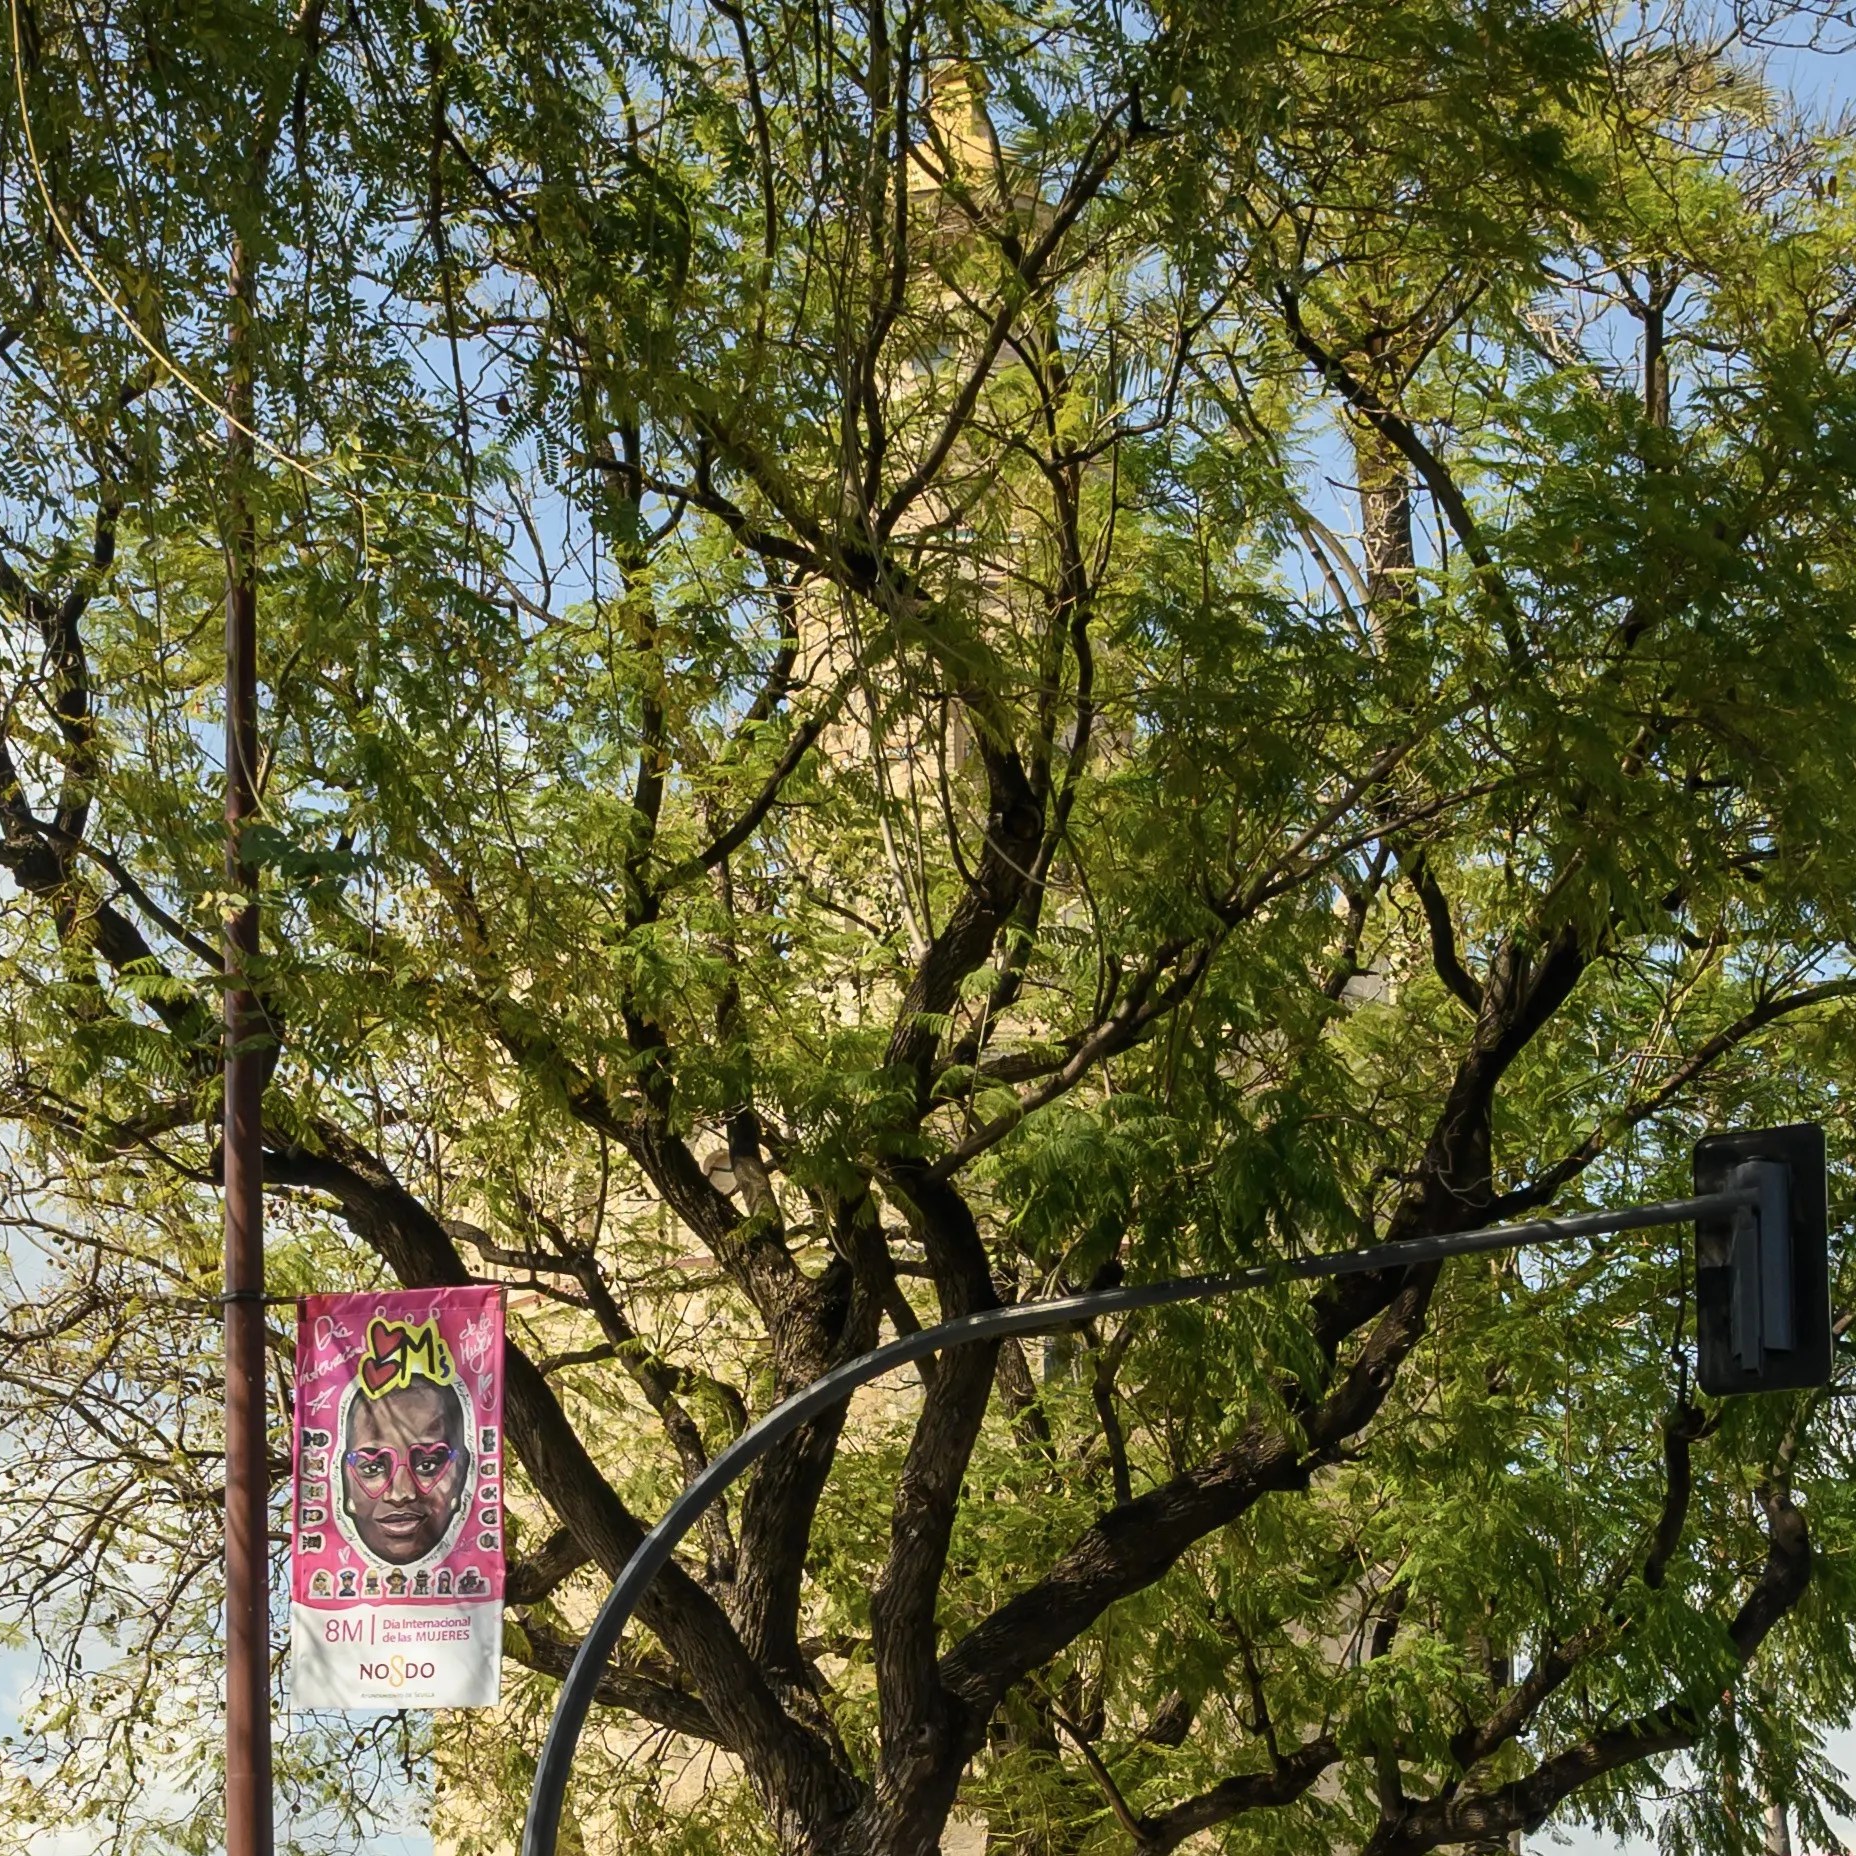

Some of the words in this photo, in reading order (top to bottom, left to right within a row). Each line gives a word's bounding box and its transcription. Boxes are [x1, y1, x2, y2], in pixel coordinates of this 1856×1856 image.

[326, 1619, 362, 1642] 8M
[403, 1616, 471, 1628] Internacional
[382, 1632, 396, 1642] de
[398, 1632, 412, 1642] las
[416, 1630, 470, 1641] MUJERES
